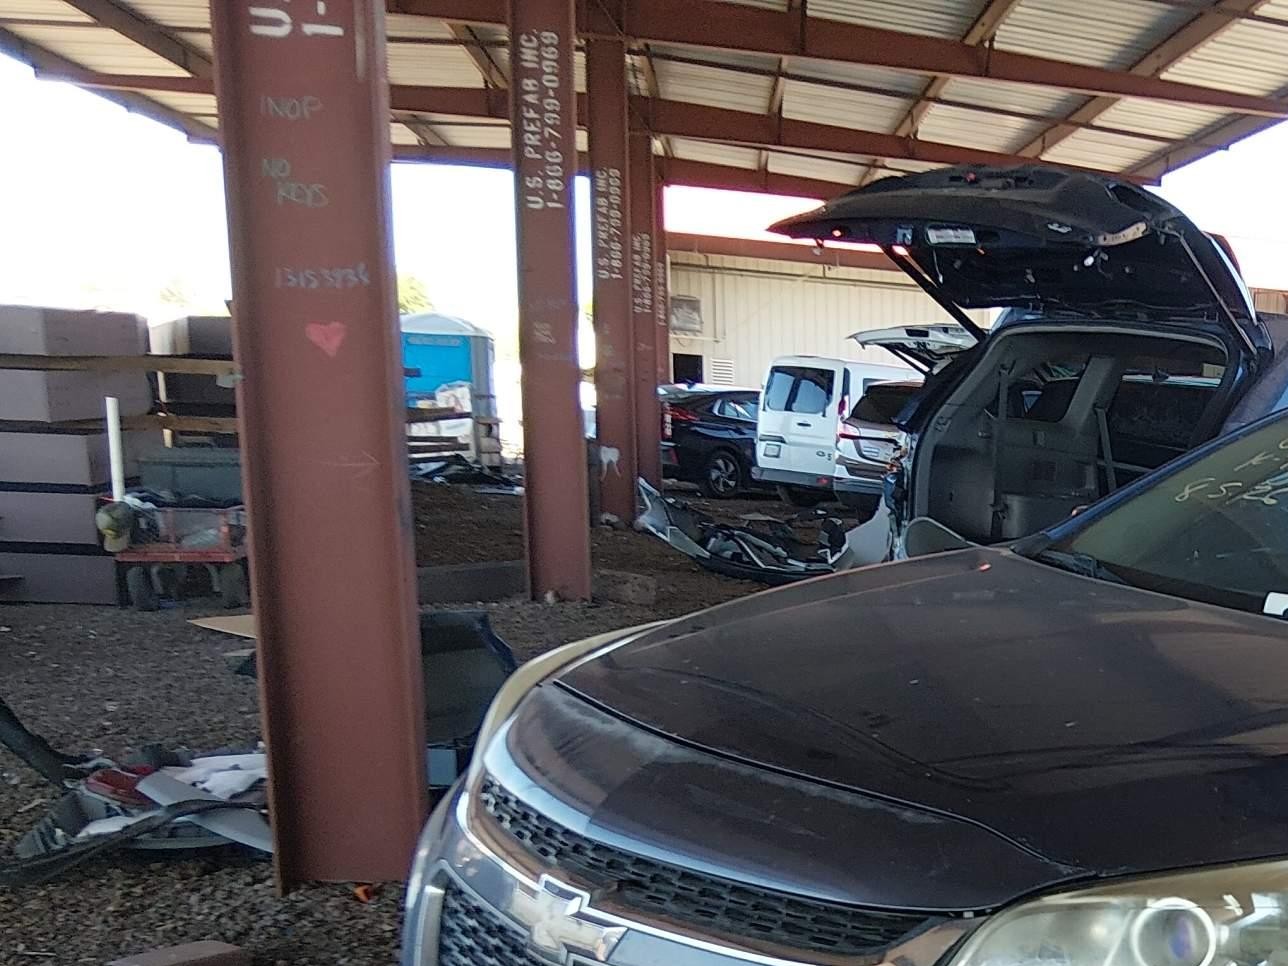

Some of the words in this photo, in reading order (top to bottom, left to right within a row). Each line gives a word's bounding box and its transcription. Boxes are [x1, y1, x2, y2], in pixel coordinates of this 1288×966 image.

[519, 28, 540, 69] INC.
[521, 78, 543, 159] PREFAB
[540, 31, 566, 209] 1-866-799-0969
[525, 170, 545, 210] U.S.
